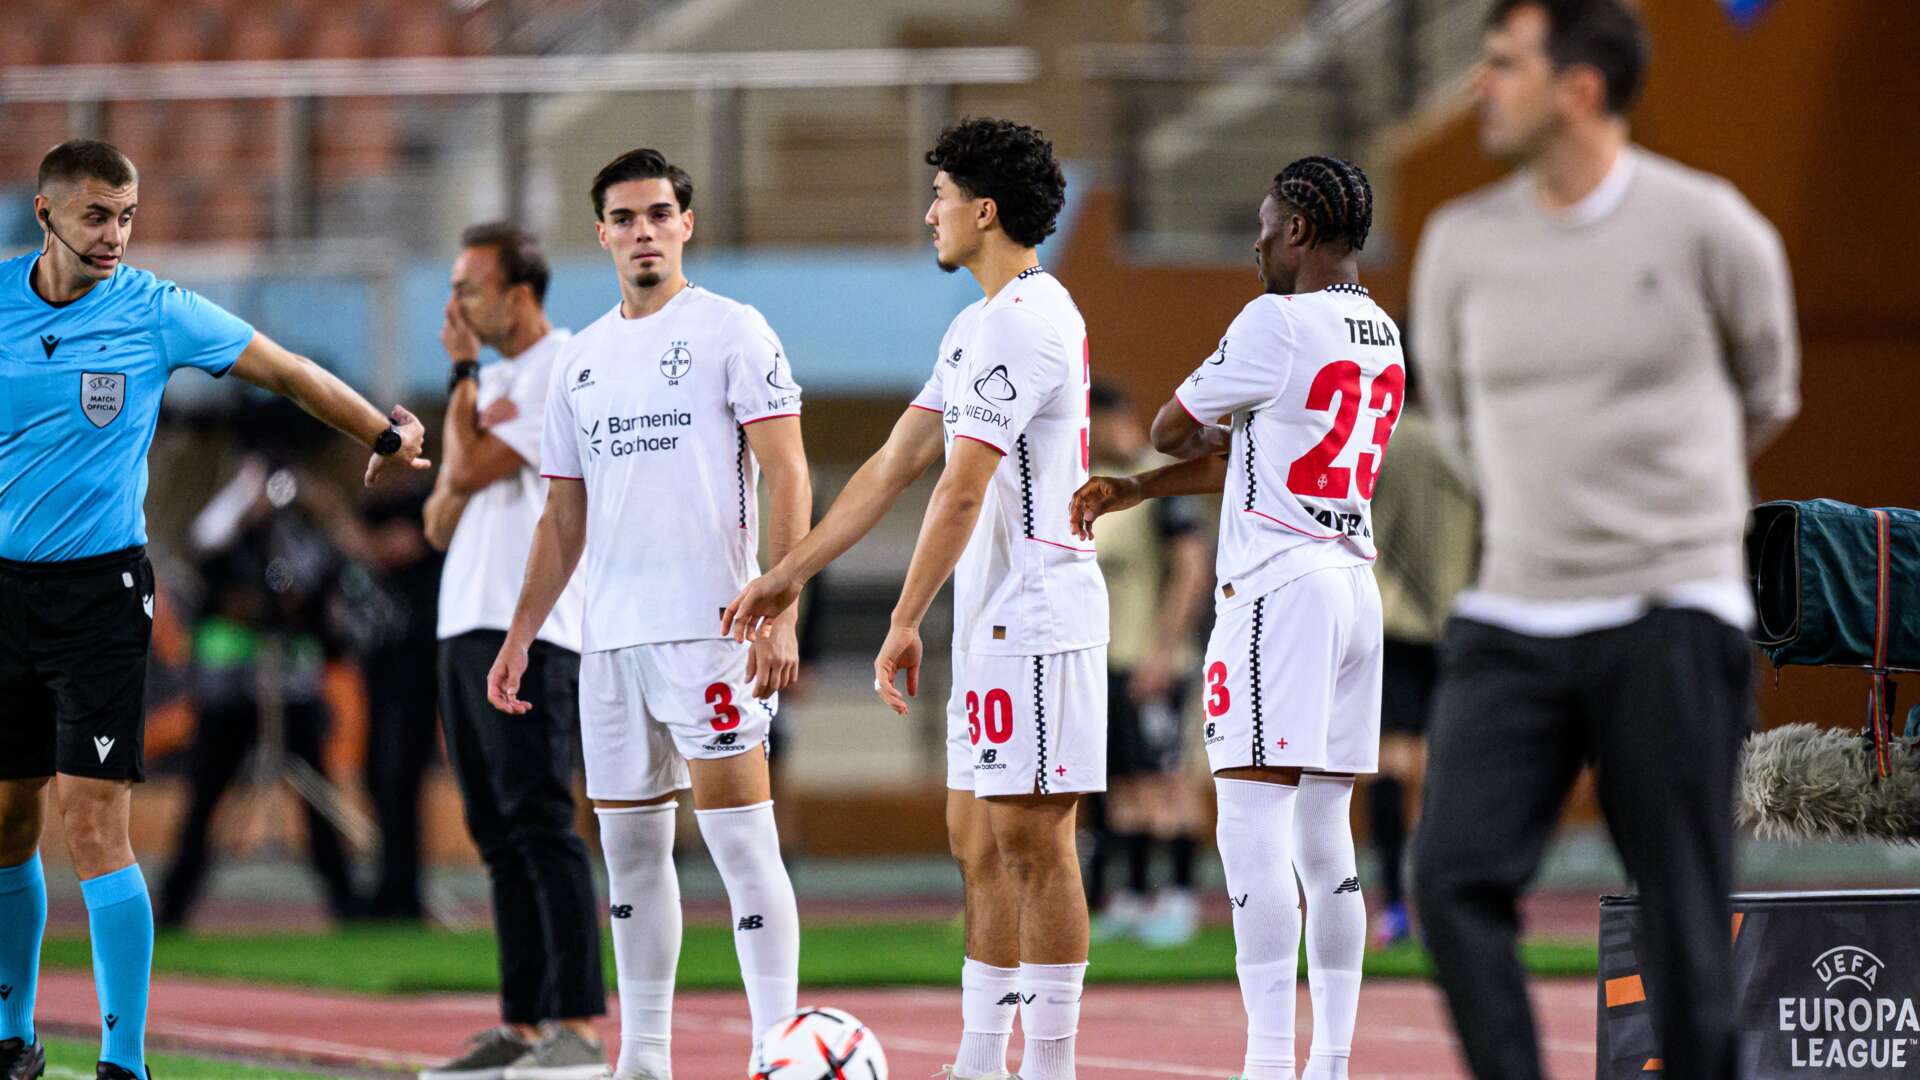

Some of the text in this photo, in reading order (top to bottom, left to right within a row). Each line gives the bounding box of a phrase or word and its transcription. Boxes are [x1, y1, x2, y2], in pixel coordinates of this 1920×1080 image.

[1344, 317, 1395, 346] TELLA
[87, 403, 118, 411] OFFICIAL
[608, 408, 692, 434] Barmenia
[963, 404, 1012, 430] NIEDAX
[1286, 361, 1405, 500] 23
[1202, 661, 1230, 718] 3
[705, 682, 740, 731] 3
[966, 688, 1013, 746] 30
[1816, 953, 1878, 985] UEFA
[1778, 997, 1920, 1032] EUROPA
[1791, 1038, 1907, 1068] LEAGUE
